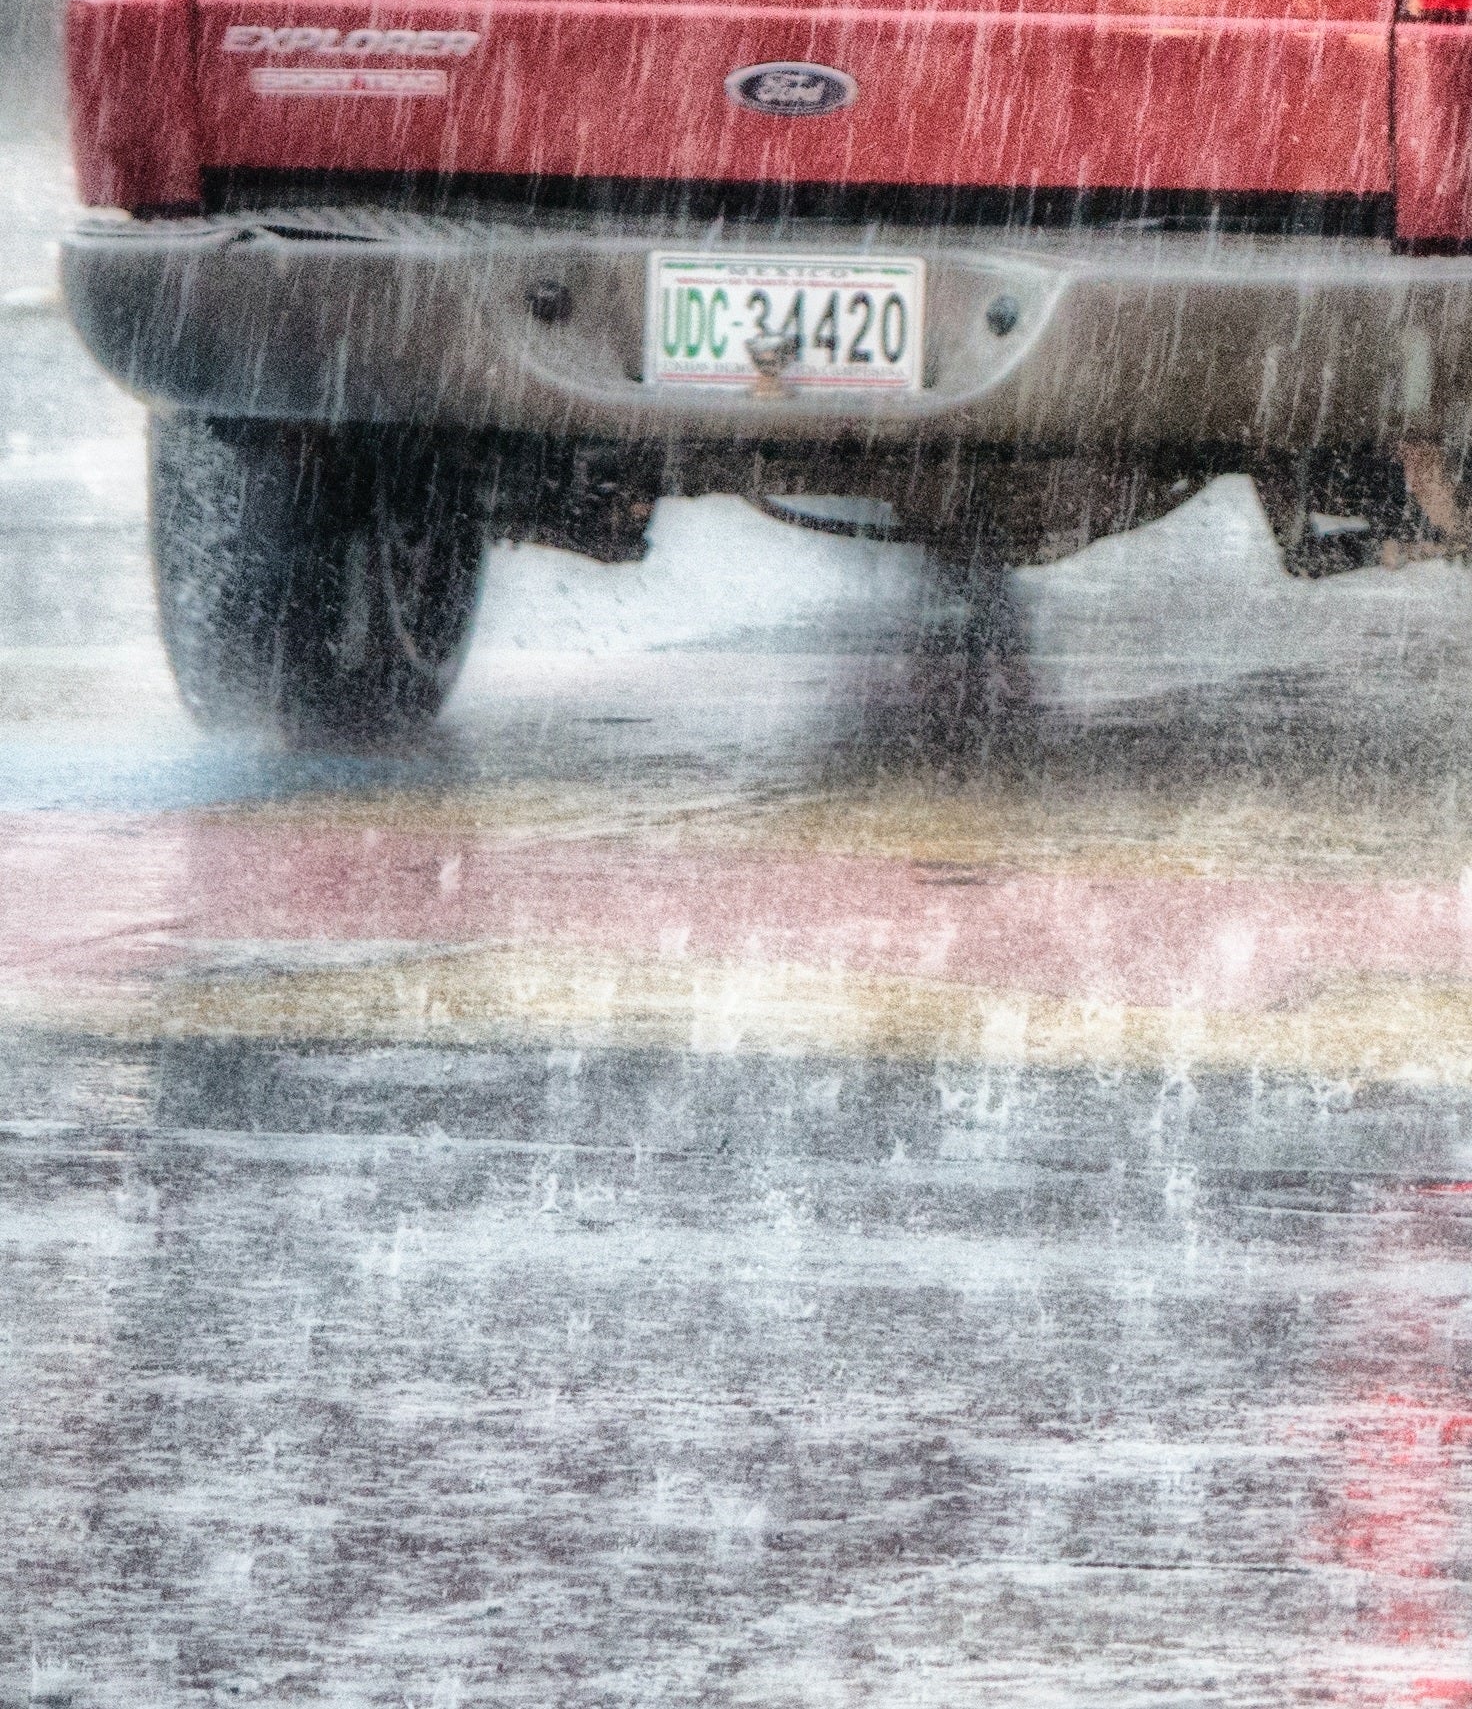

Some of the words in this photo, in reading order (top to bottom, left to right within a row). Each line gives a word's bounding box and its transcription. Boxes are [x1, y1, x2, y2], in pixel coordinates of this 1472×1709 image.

[222, 26, 480, 56] EXPLORER
[728, 263, 849, 279] MEXICO
[661, 288, 908, 363] UDC-34420
